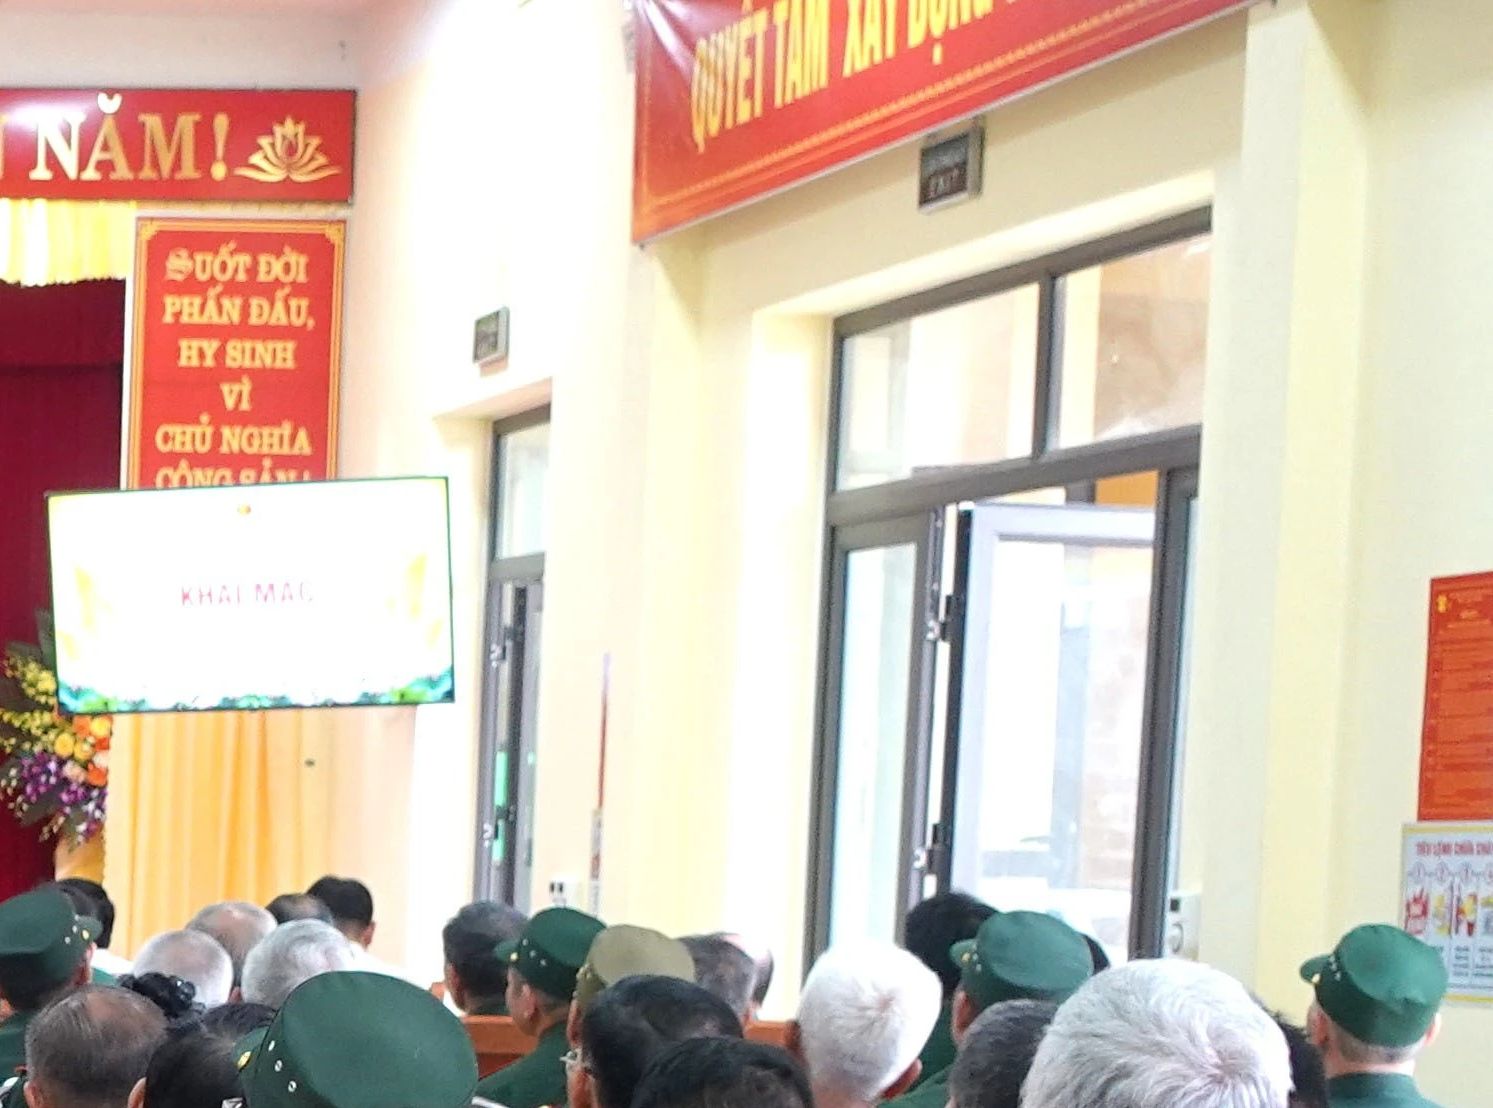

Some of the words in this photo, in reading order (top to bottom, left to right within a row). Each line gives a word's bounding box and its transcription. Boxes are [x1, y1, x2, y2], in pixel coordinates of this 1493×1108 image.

[29, 92, 230, 182] NĂM!
[165, 240, 252, 282] SUỐT
[256, 244, 309, 283] ĐỜI
[163, 283, 243, 325] PHẤN
[249, 284, 316, 331] ĐẤU,
[178, 337, 221, 368] HY
[225, 339, 298, 369] SINH
[220, 374, 253, 412] VÌ
[155, 411, 213, 453] CHỦ
[221, 420, 313, 456] NGHĨA
[180, 583, 242, 607] KHAI
